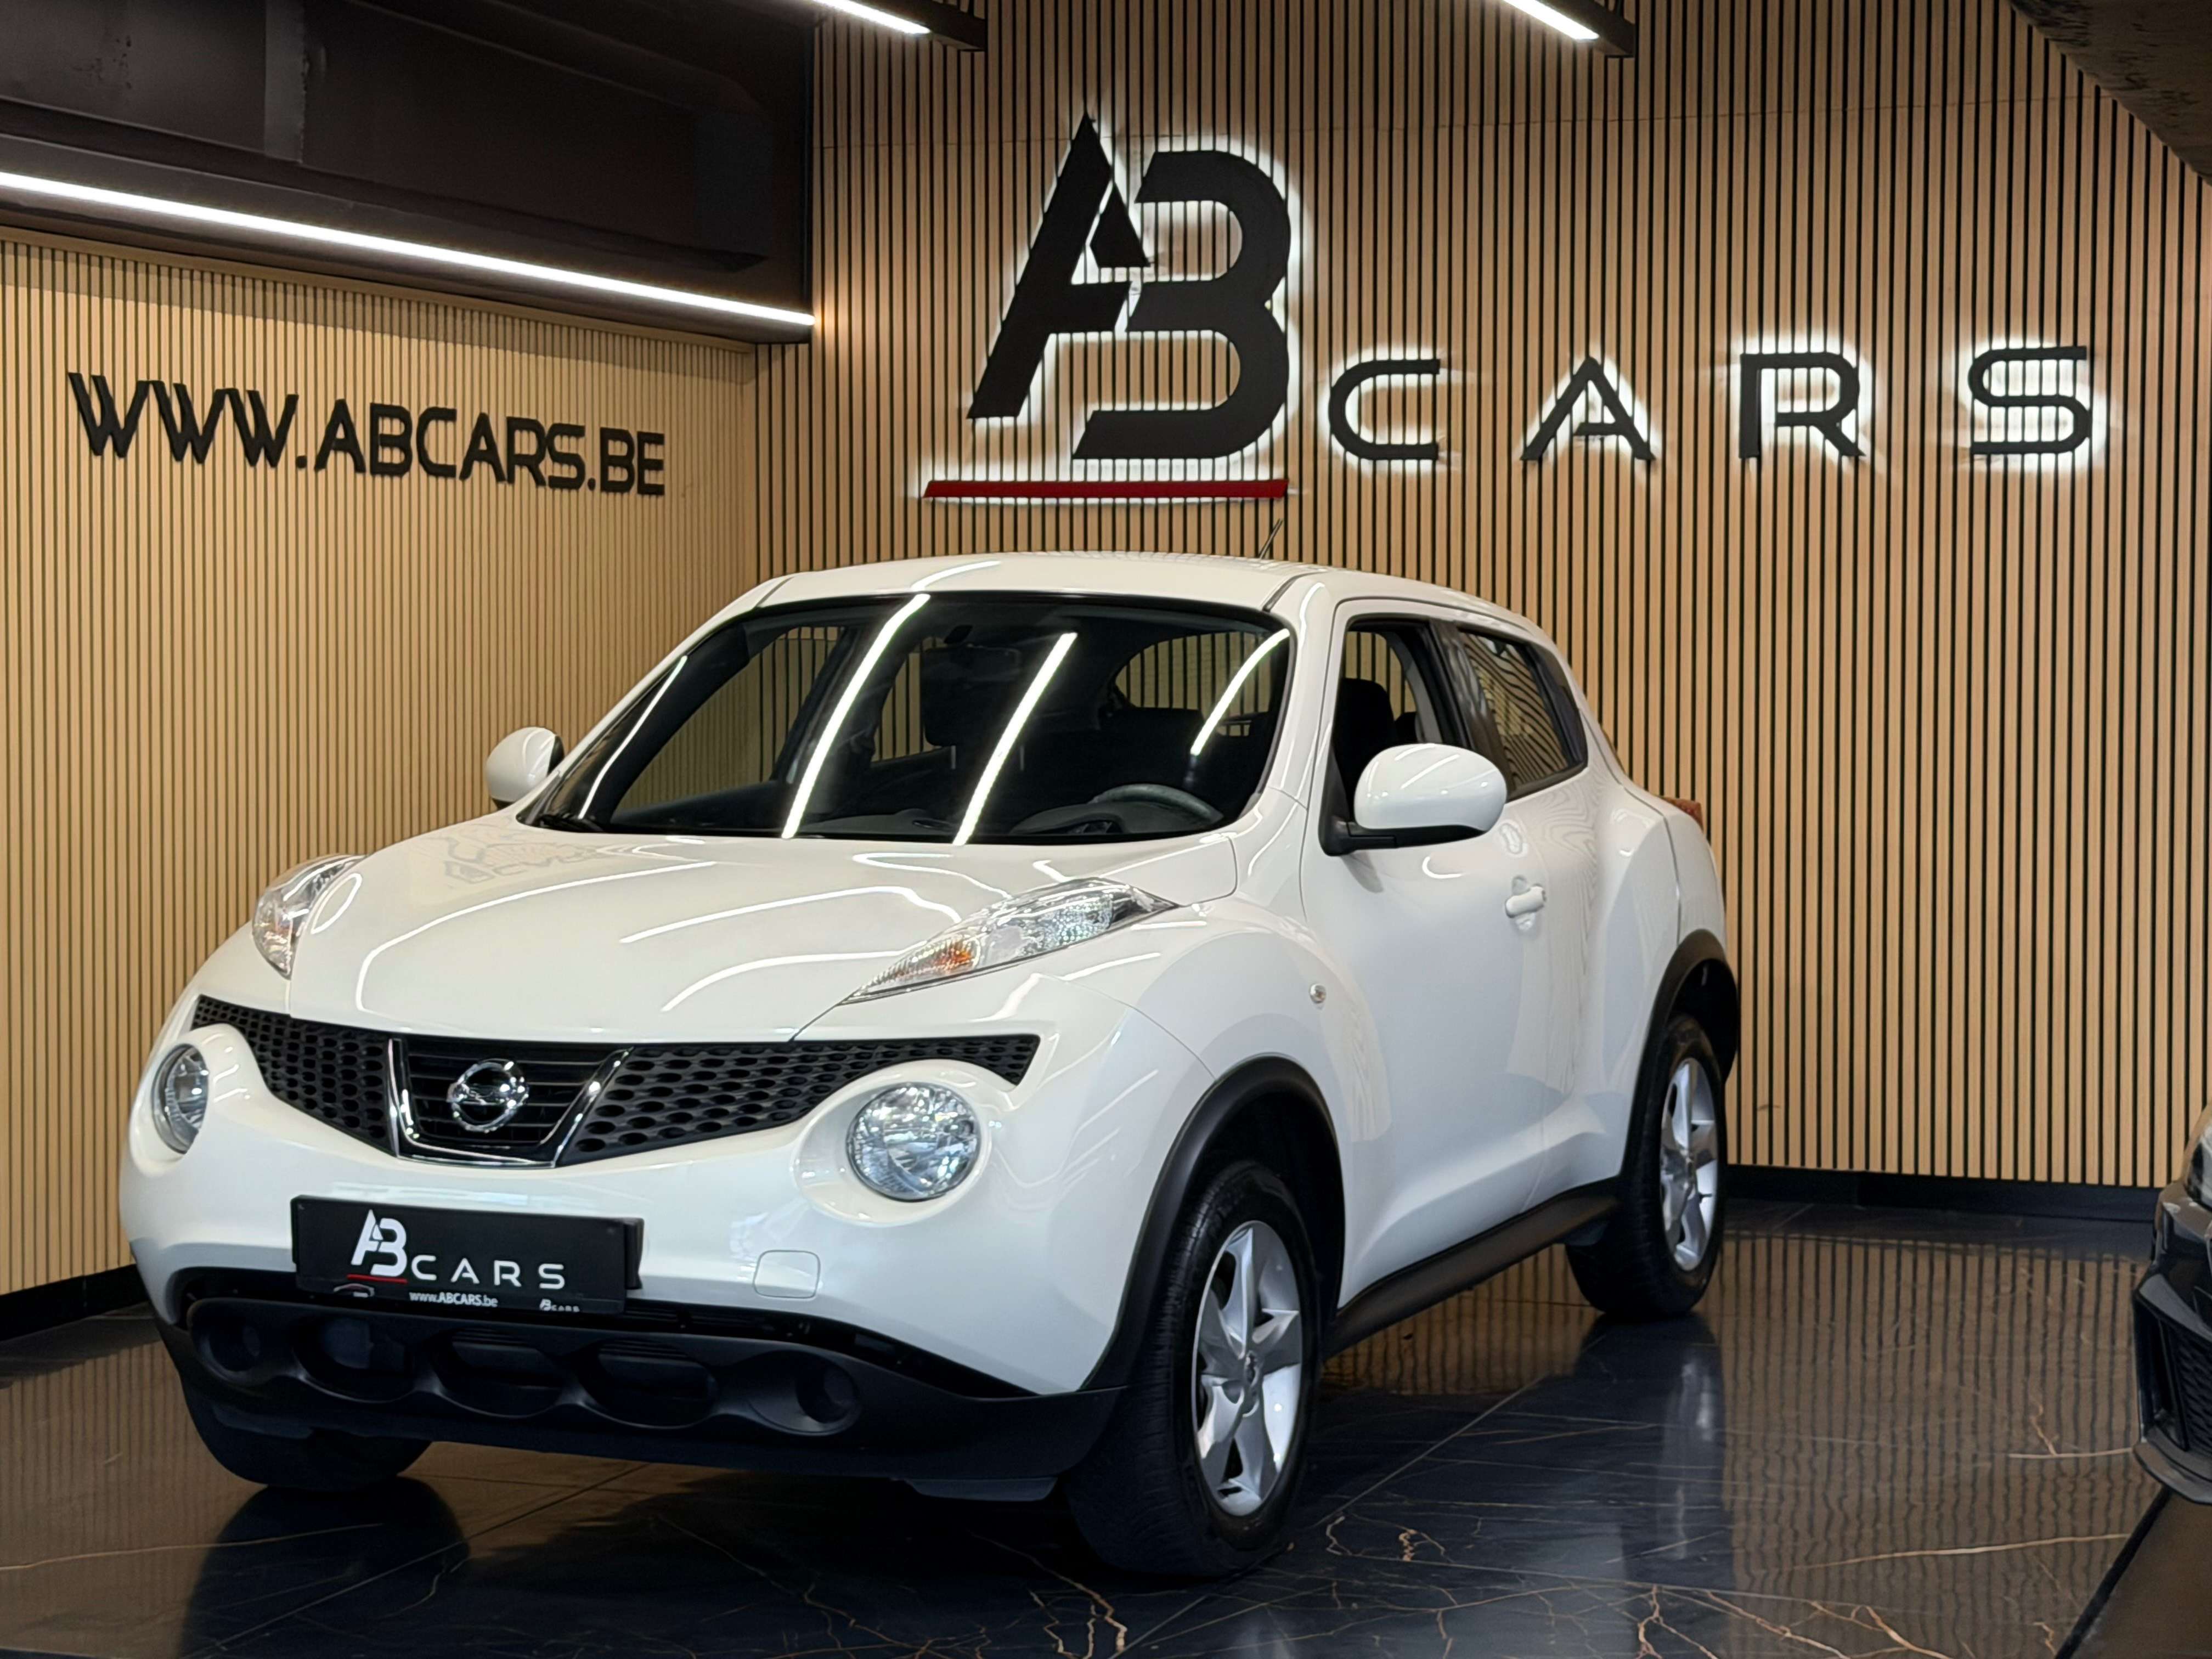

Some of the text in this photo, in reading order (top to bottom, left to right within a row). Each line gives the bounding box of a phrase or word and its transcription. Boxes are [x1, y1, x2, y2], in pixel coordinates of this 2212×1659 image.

[67, 371, 664, 495] WWW.ABCARS.BE
[1328, 346, 2092, 462] CARS
[409, 1291, 498, 1308] www.ABCARS.be
[411, 1255, 566, 1289] CARS
